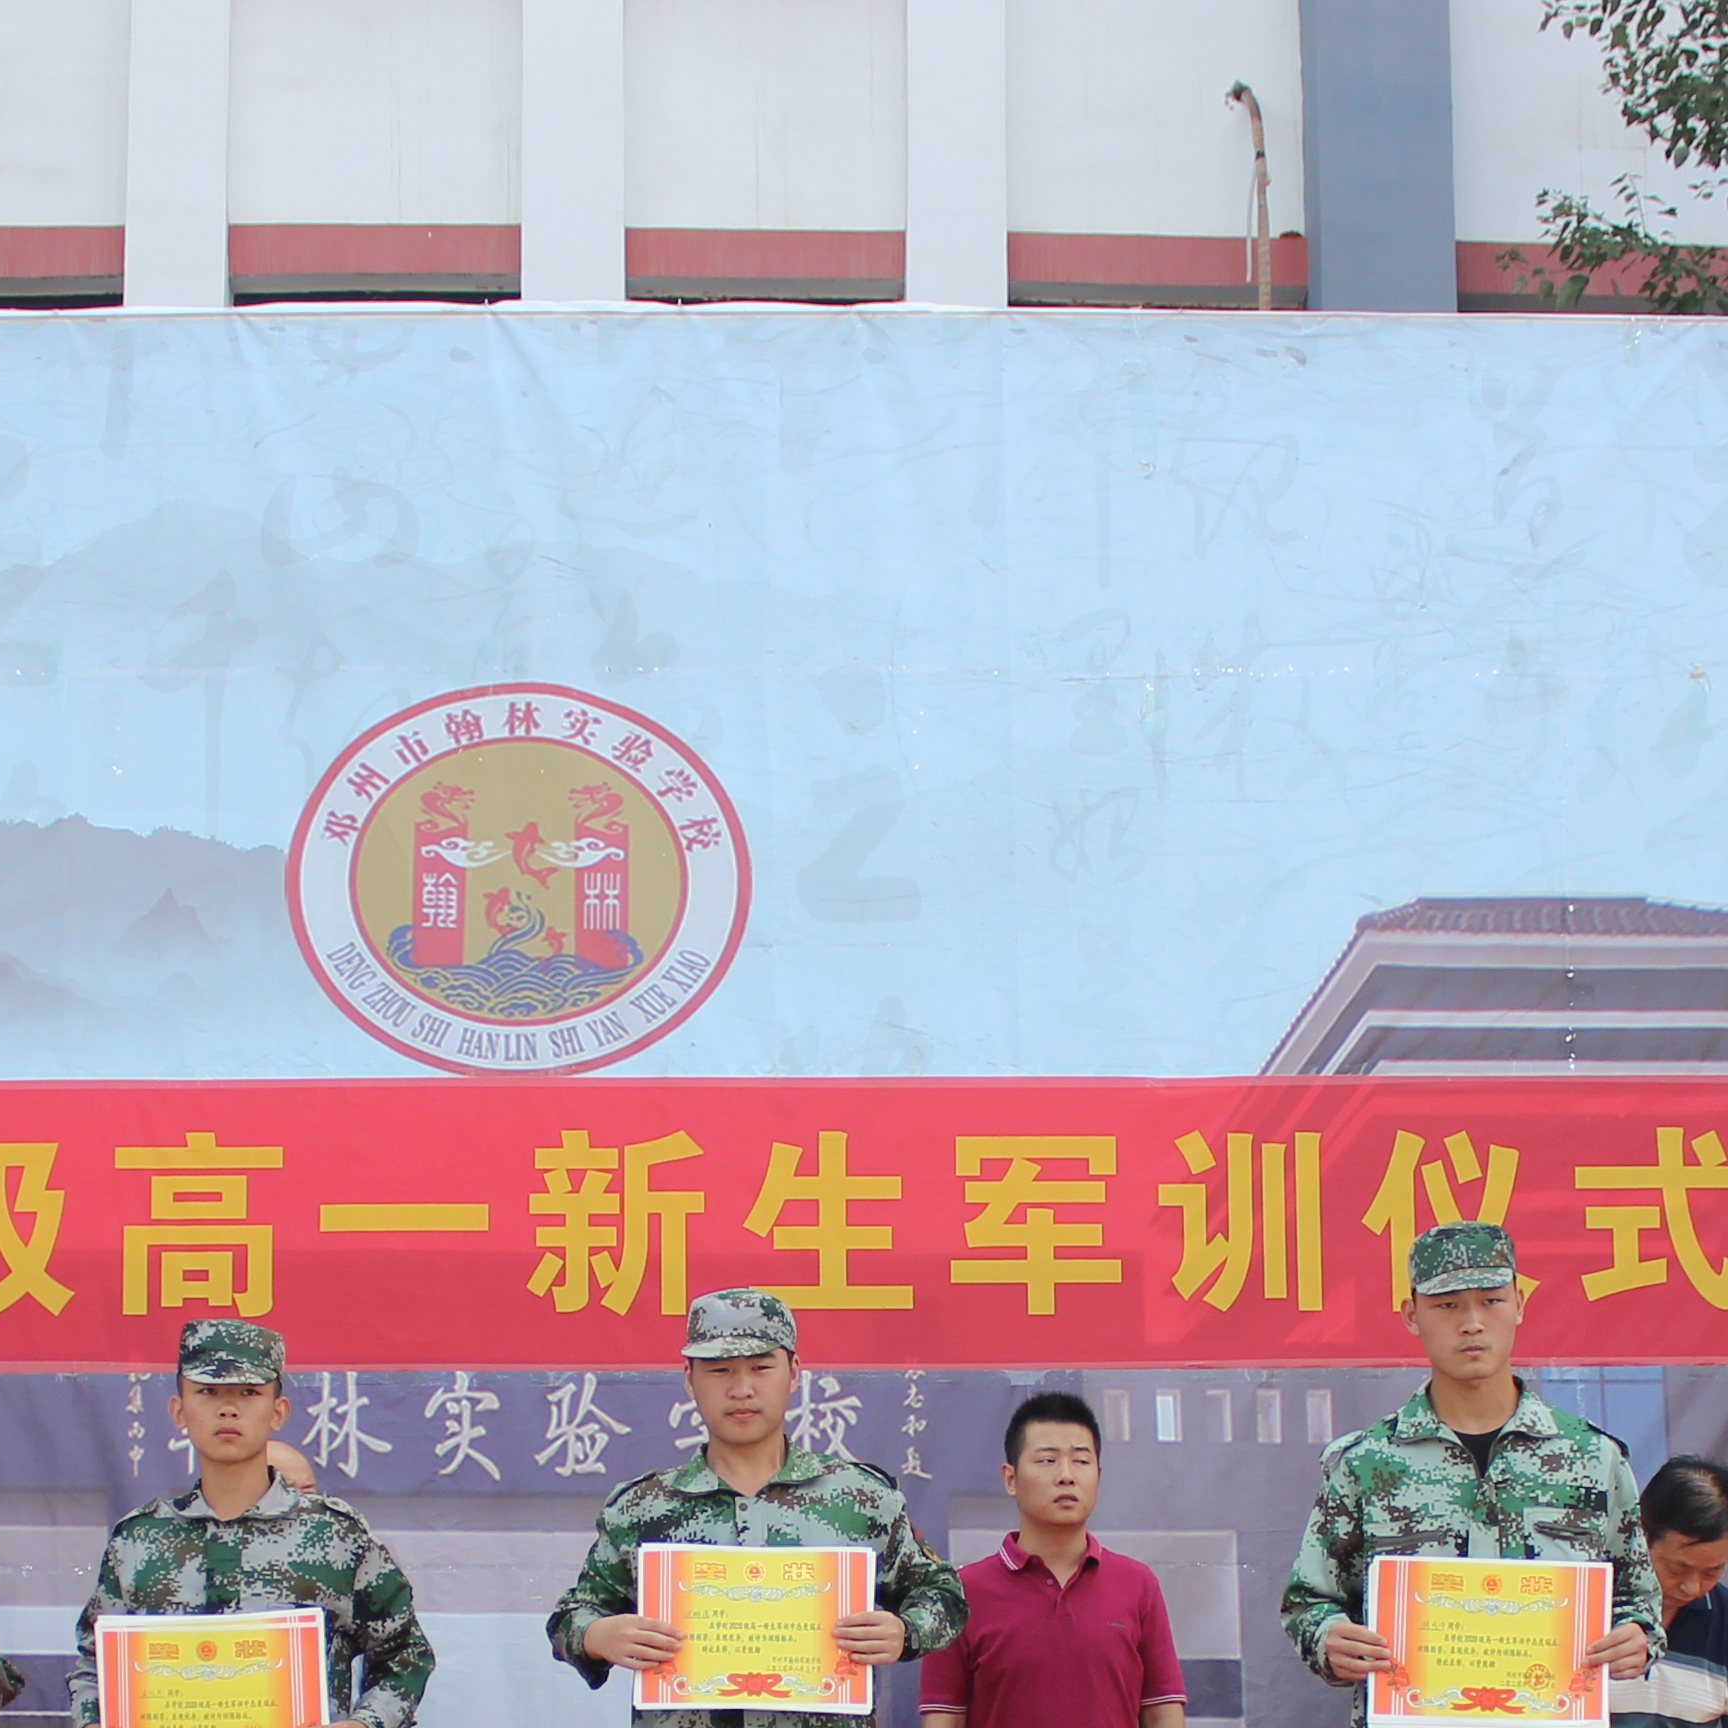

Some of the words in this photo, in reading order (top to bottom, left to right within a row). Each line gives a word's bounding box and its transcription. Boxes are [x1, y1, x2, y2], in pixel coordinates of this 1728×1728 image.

[320, 700, 725, 856] 邓州市翰林实验学校
[325, 940, 376, 991] DENG
[360, 977, 415, 1029] ZHOU
[409, 1010, 449, 1048] SHI
[546, 1022, 587, 1059] SHI
[581, 1012, 630, 1049] YAN
[628, 983, 678, 1026] XUE
[661, 948, 713, 994] XIAO
